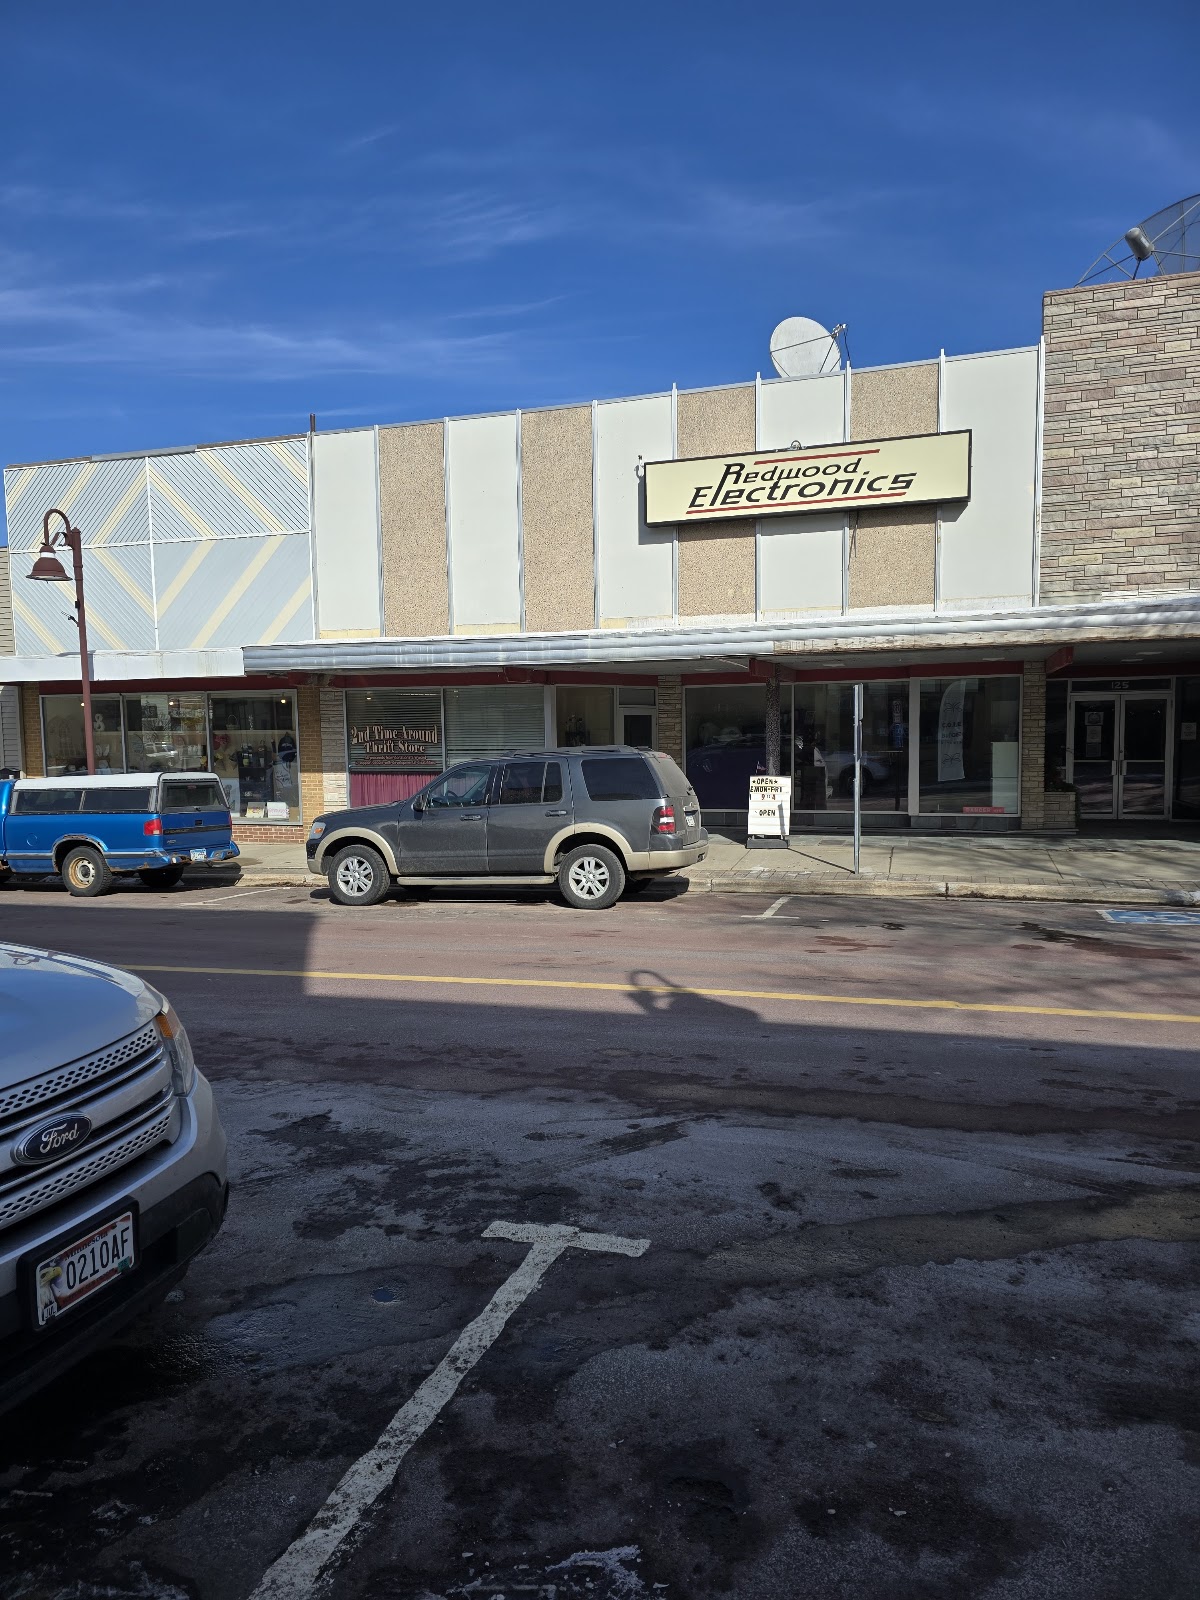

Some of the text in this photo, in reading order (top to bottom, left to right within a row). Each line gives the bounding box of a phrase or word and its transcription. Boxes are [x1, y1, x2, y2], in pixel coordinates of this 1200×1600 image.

[724, 457, 862, 485] Redwood
[688, 470, 918, 508] Electronics
[1111, 681, 1130, 689] 125
[351, 725, 438, 745] 2nd Time Around
[364, 740, 425, 753] Thrift Store
[39, 1122, 80, 1154] Ford
[66, 1226, 130, 1290] 0210AF
